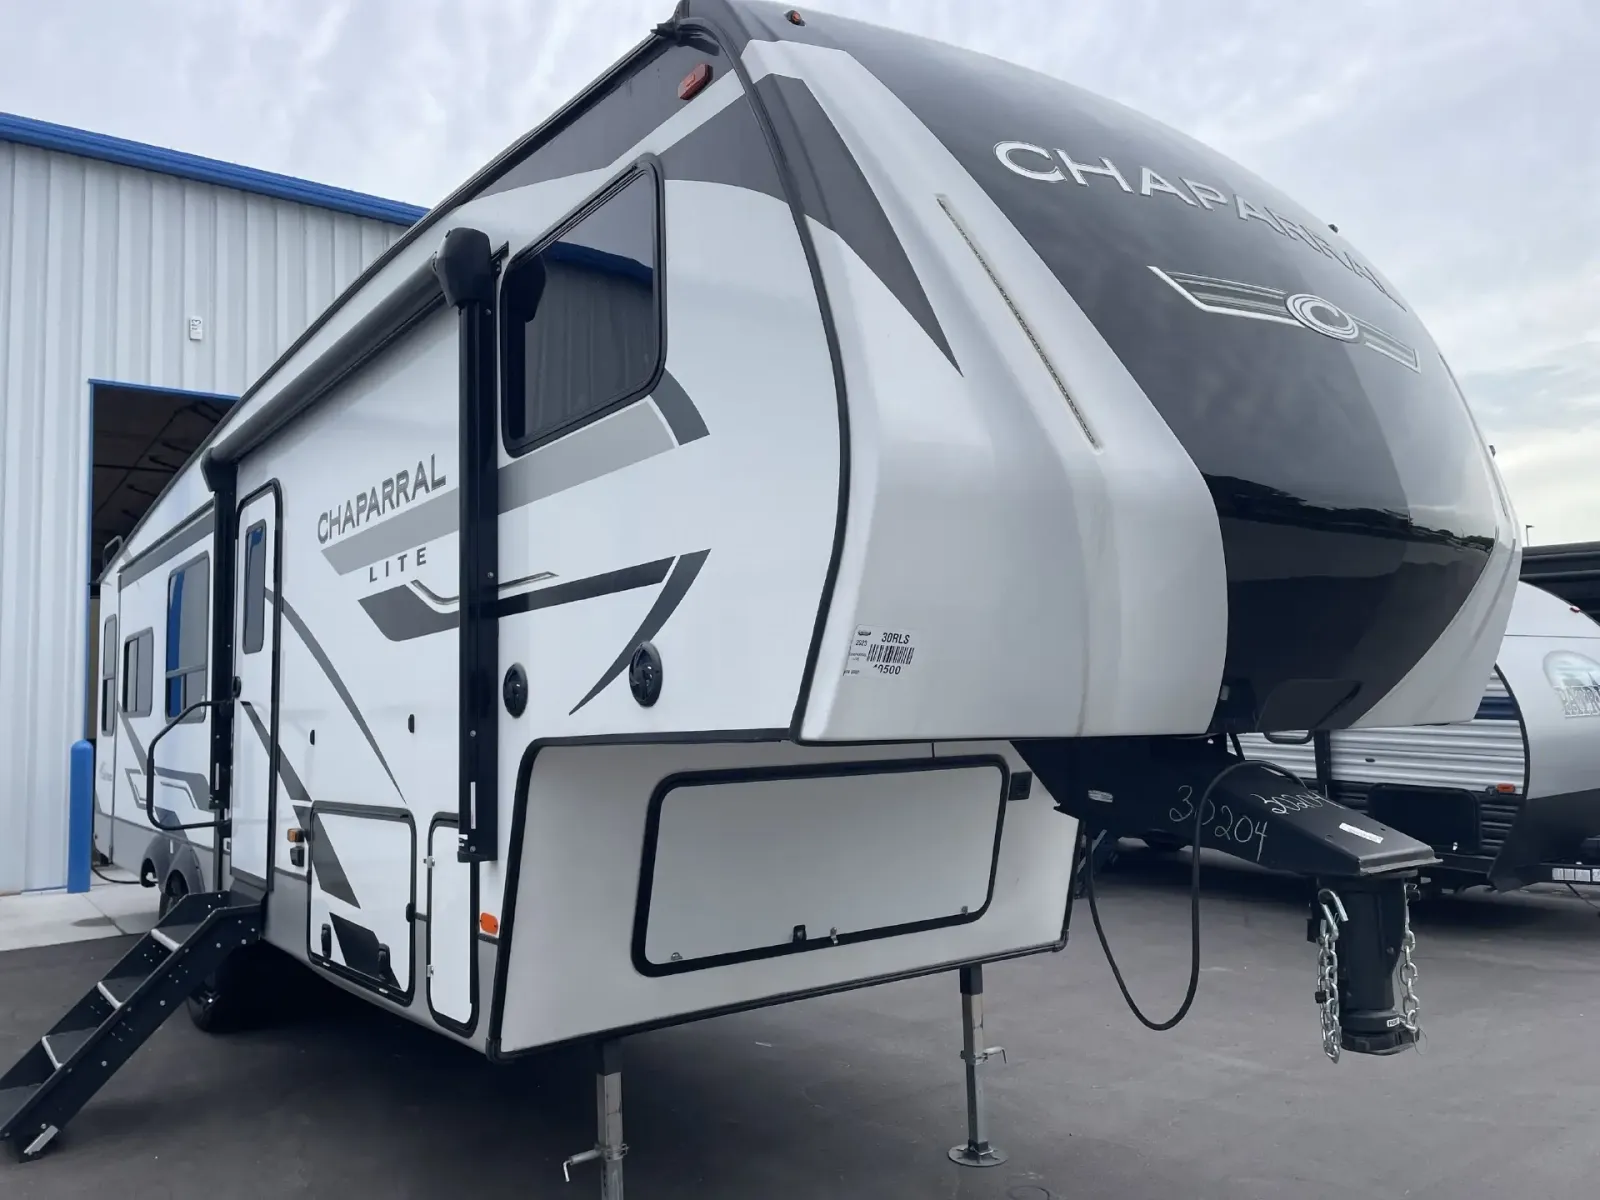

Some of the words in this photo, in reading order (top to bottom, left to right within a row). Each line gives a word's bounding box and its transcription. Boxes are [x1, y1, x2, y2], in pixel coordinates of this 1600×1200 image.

[993, 140, 1407, 312] CHAPARRAL
[317, 453, 447, 544] CHAPARRAL
[369, 546, 427, 582] LITE
[881, 632, 910, 645] 30RLS
